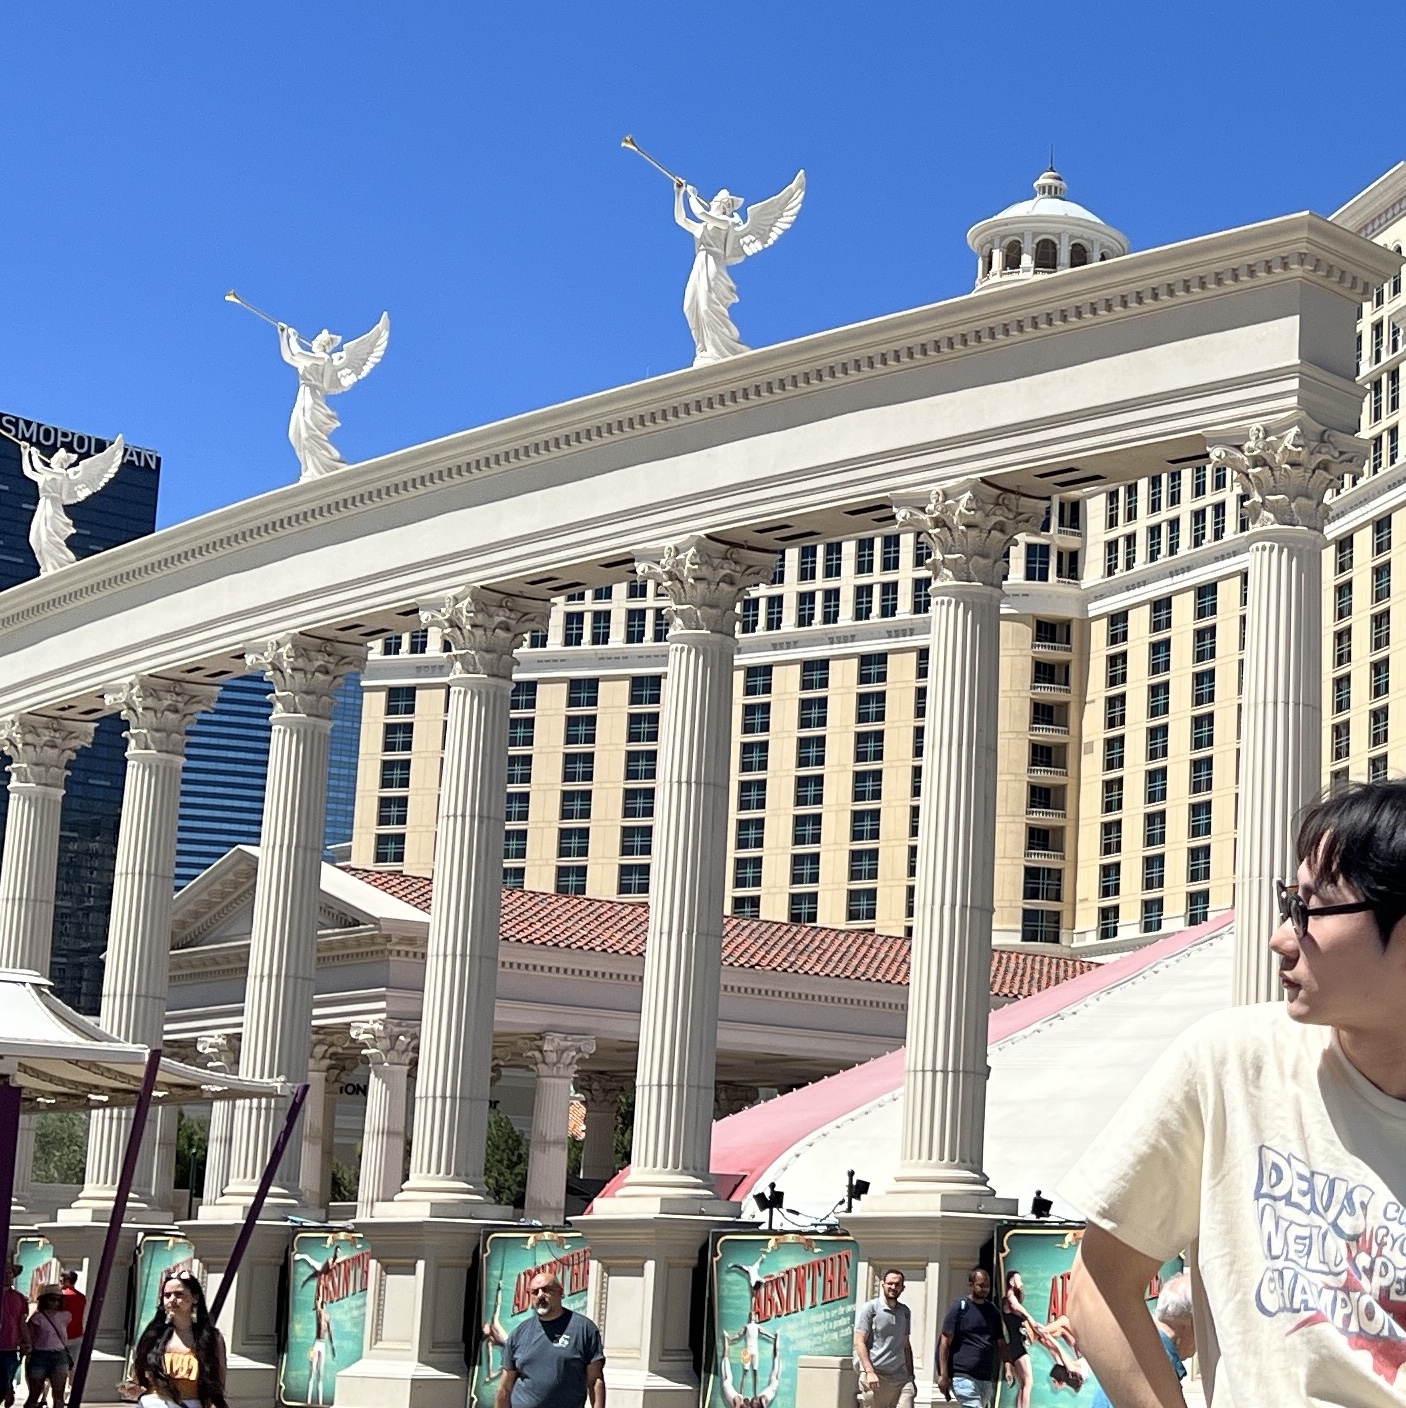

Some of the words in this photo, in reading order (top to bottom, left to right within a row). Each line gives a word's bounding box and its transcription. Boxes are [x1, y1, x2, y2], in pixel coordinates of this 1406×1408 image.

[1, 415, 157, 470] SMOPOLAN
[1254, 1144, 1375, 1242] DEUS
[752, 1249, 852, 1324] ABSINTHE
